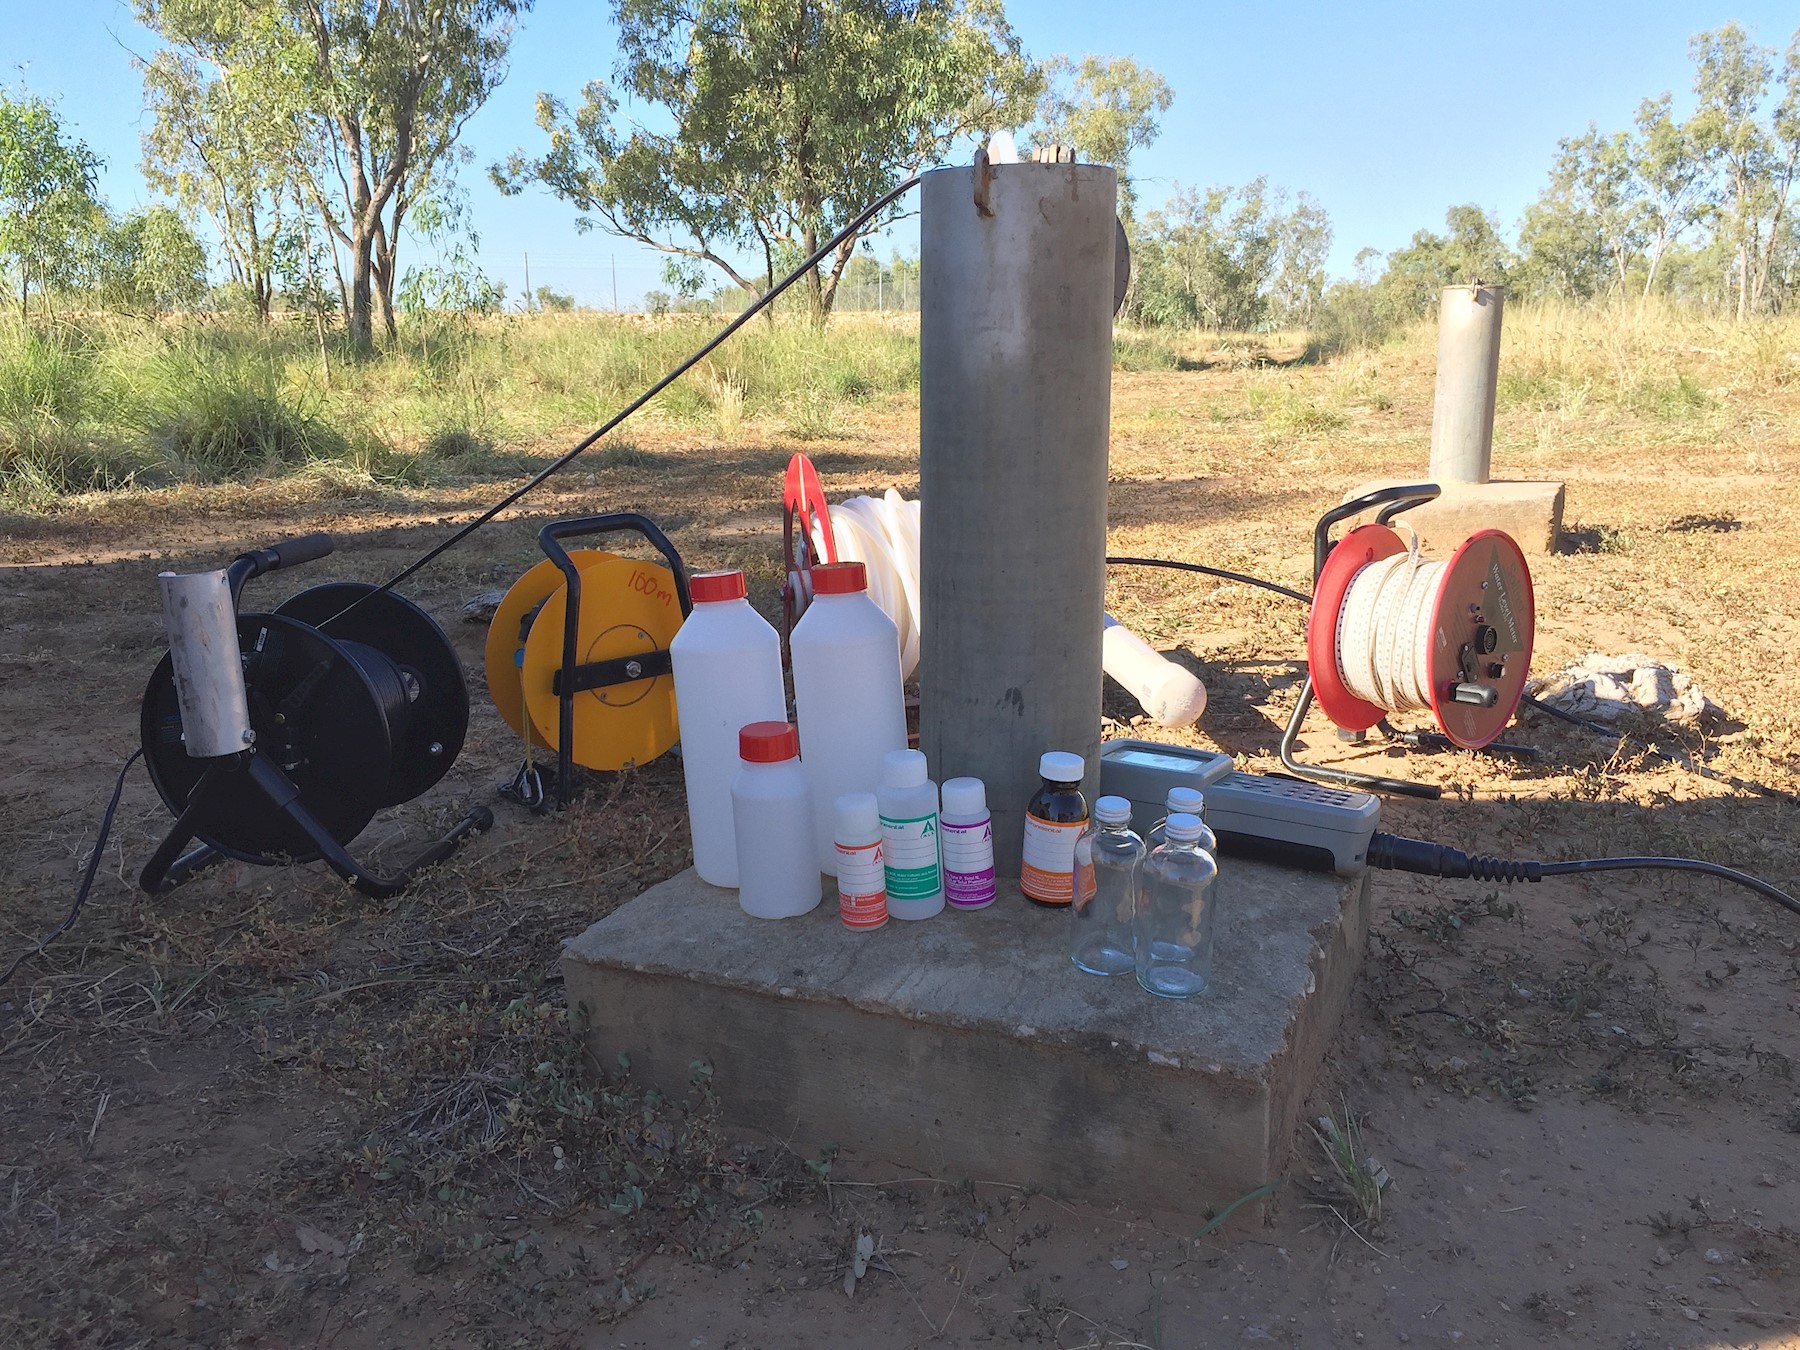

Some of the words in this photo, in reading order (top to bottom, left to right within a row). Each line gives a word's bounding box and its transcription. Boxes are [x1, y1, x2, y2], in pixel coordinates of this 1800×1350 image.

[1492, 563, 1504, 591] Water
[1500, 592, 1512, 617] Level
[1507, 616, 1518, 643] Meter
